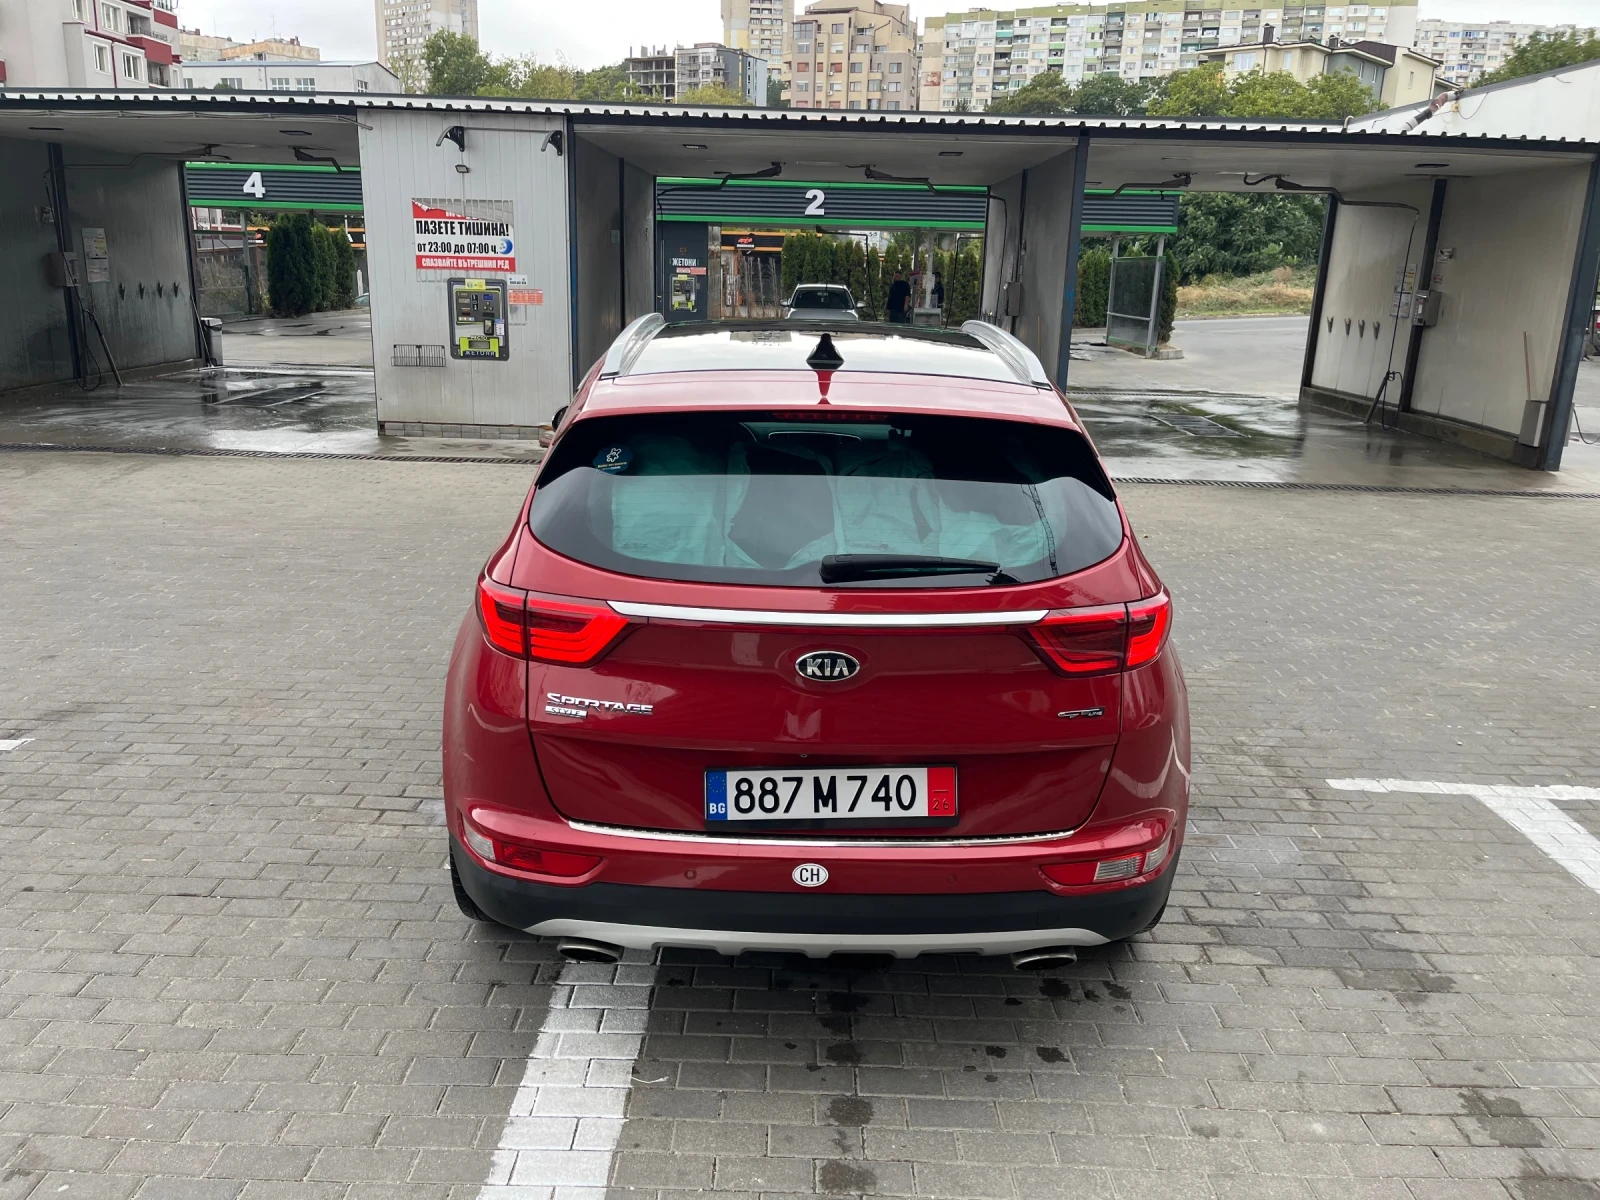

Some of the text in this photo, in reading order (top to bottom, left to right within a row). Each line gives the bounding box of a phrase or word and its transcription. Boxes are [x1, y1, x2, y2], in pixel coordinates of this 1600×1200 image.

[243, 171, 266, 198] 4
[804, 189, 825, 216] 2
[416, 220, 510, 236] ПАЗЕТЕ ТИШИНА!
[417, 241, 499, 255] от 23:00 до 07:00 ч.
[421, 257, 510, 270] СПАЗВАЙТЕ ВЪТРЕШНИЯ РЕД
[672, 257, 697, 267] ЖЕТОНИ
[806, 658, 850, 677] KIA
[546, 692, 654, 715] SPORTAGE
[551, 707, 581, 717] STYLE
[734, 774, 917, 815] 887 M 740
[709, 803, 726, 814] BG
[932, 798, 950, 811] 26
[799, 868, 820, 882] CH
